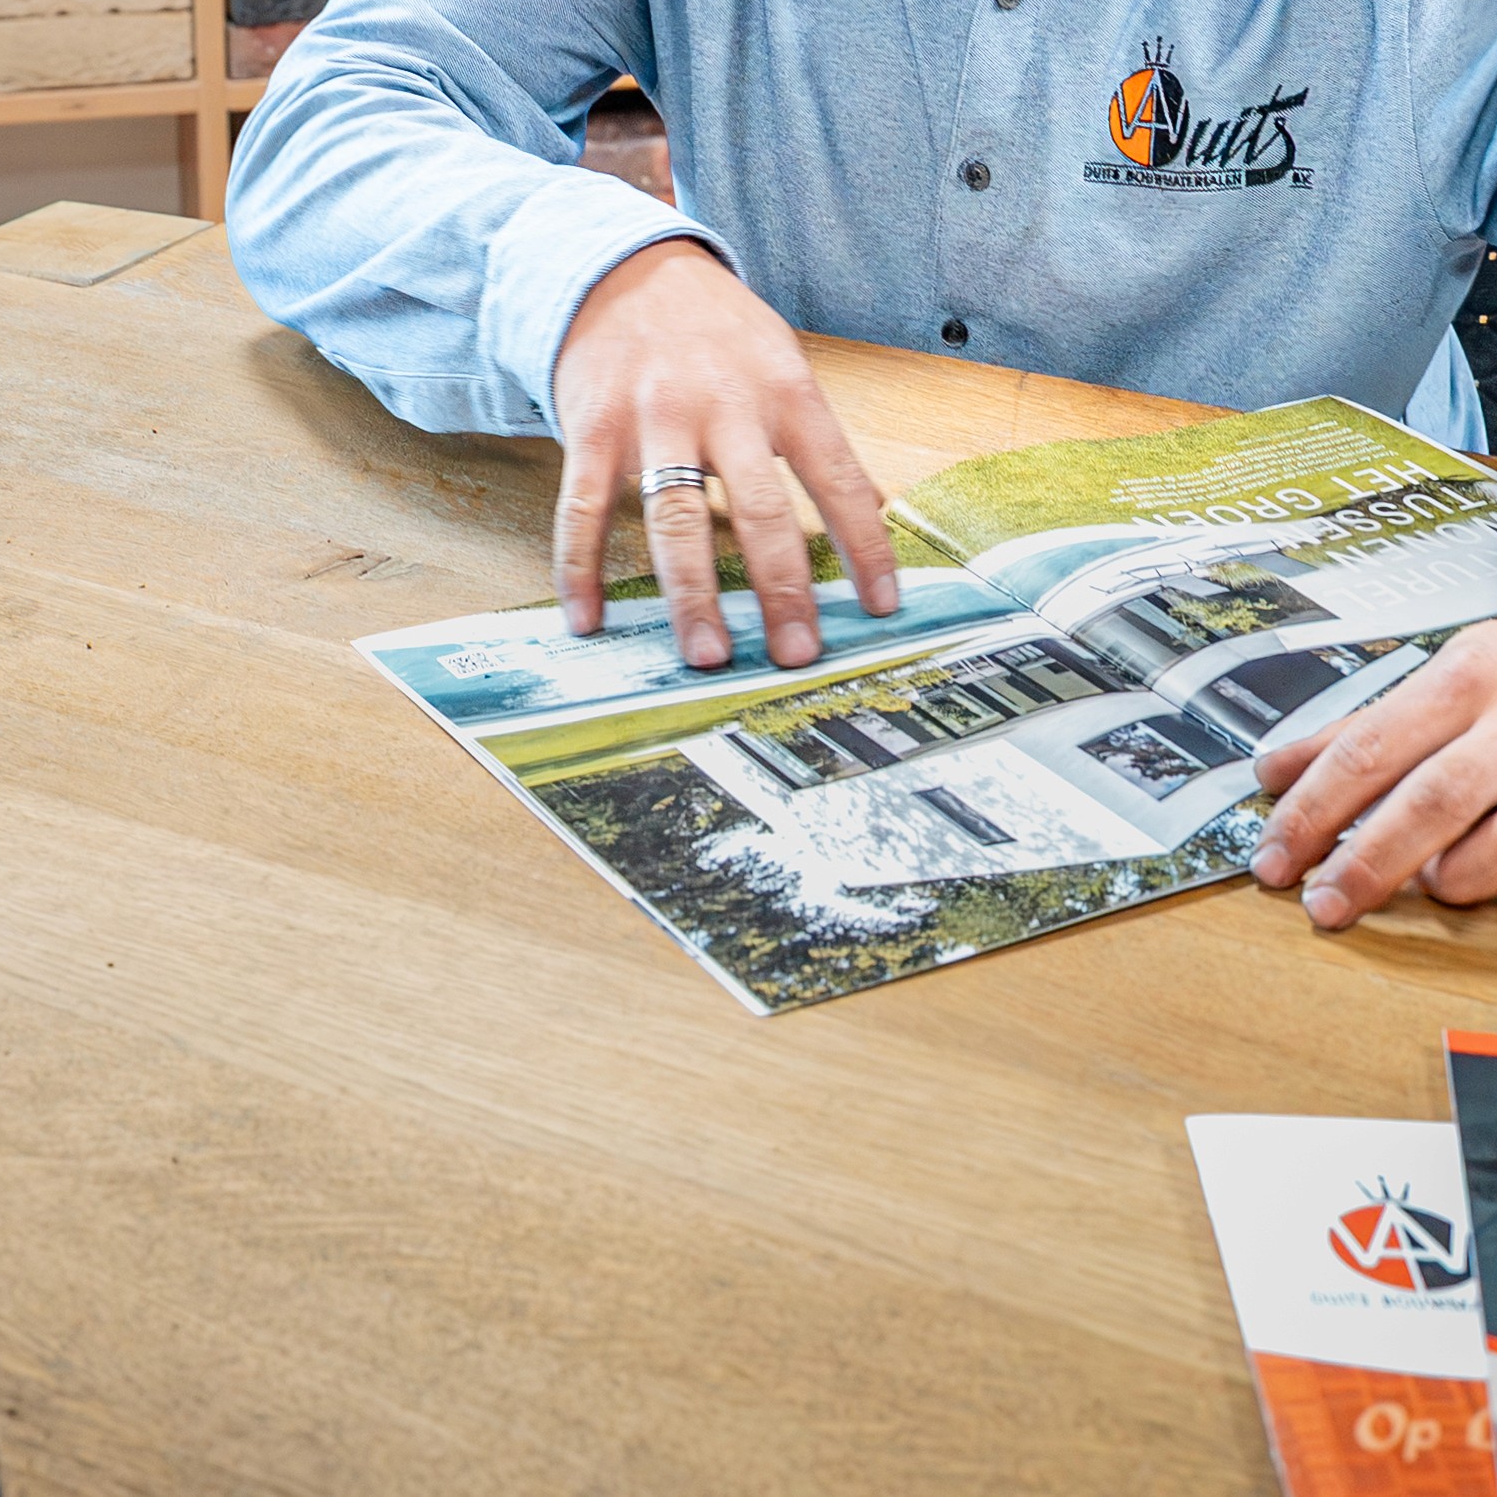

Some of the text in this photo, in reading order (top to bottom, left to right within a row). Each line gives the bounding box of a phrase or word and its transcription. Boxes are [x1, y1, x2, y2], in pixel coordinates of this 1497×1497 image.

[1333, 459, 1437, 499] HET
[1130, 486, 1321, 538] GROEN
[1264, 480, 1486, 552] TUSSEN
[1354, 1402, 1442, 1463] Op
